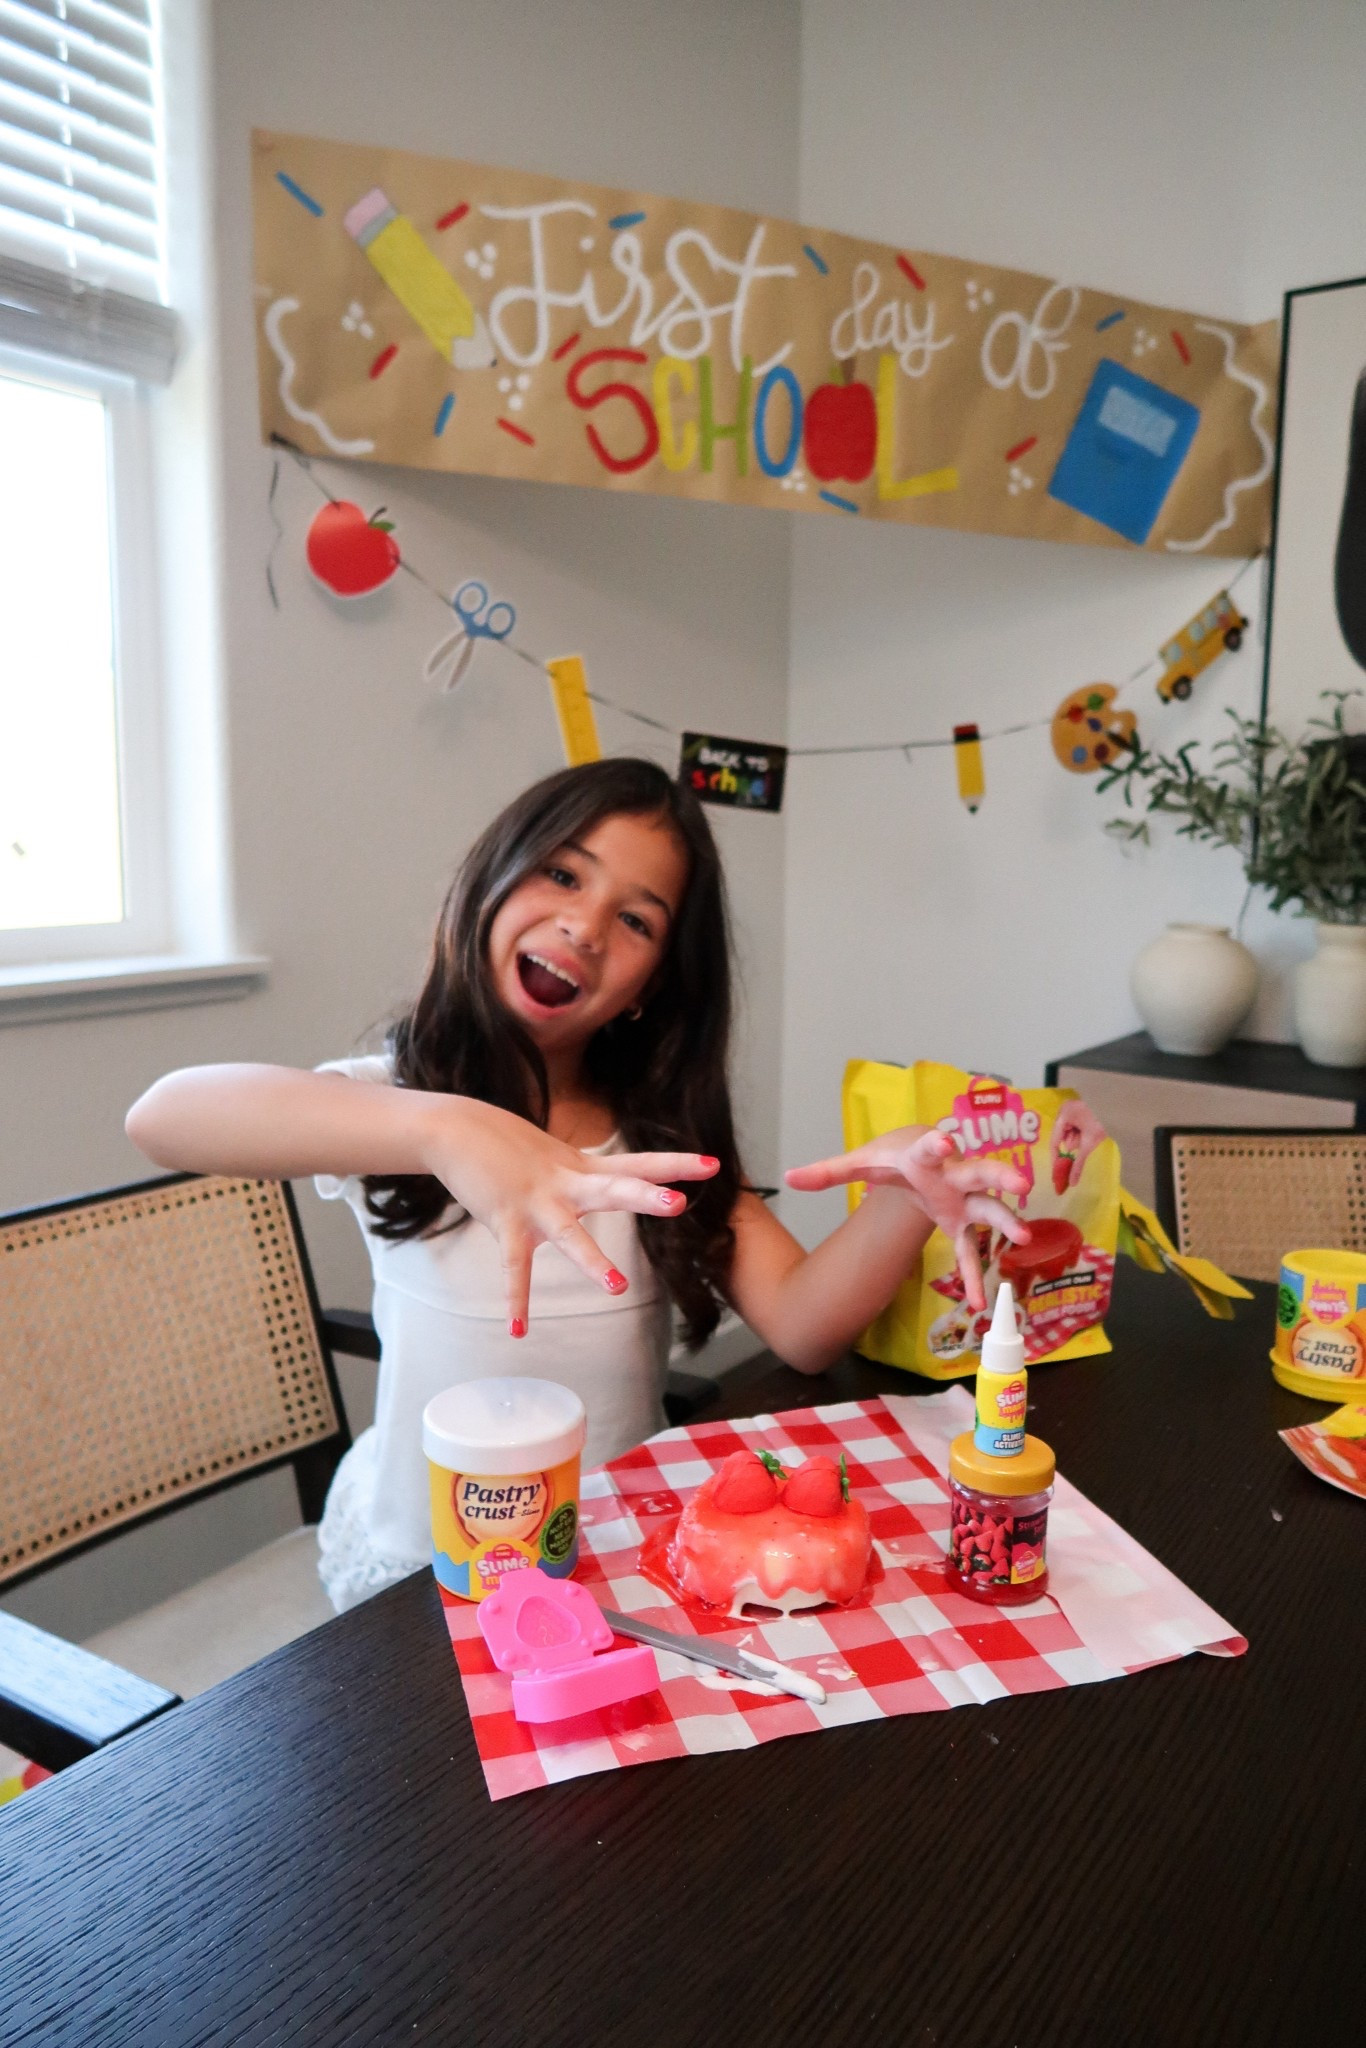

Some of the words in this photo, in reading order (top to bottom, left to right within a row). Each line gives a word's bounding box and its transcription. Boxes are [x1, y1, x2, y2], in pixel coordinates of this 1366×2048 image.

[480, 199, 798, 378] First
[830, 261, 955, 378] day
[981, 281, 1081, 400] of
[1296, 1347, 1357, 1373] Pastry
[1314, 1342, 1357, 1355] crust
[463, 1481, 541, 1507] Pastry
[464, 1504, 517, 1520] crust
